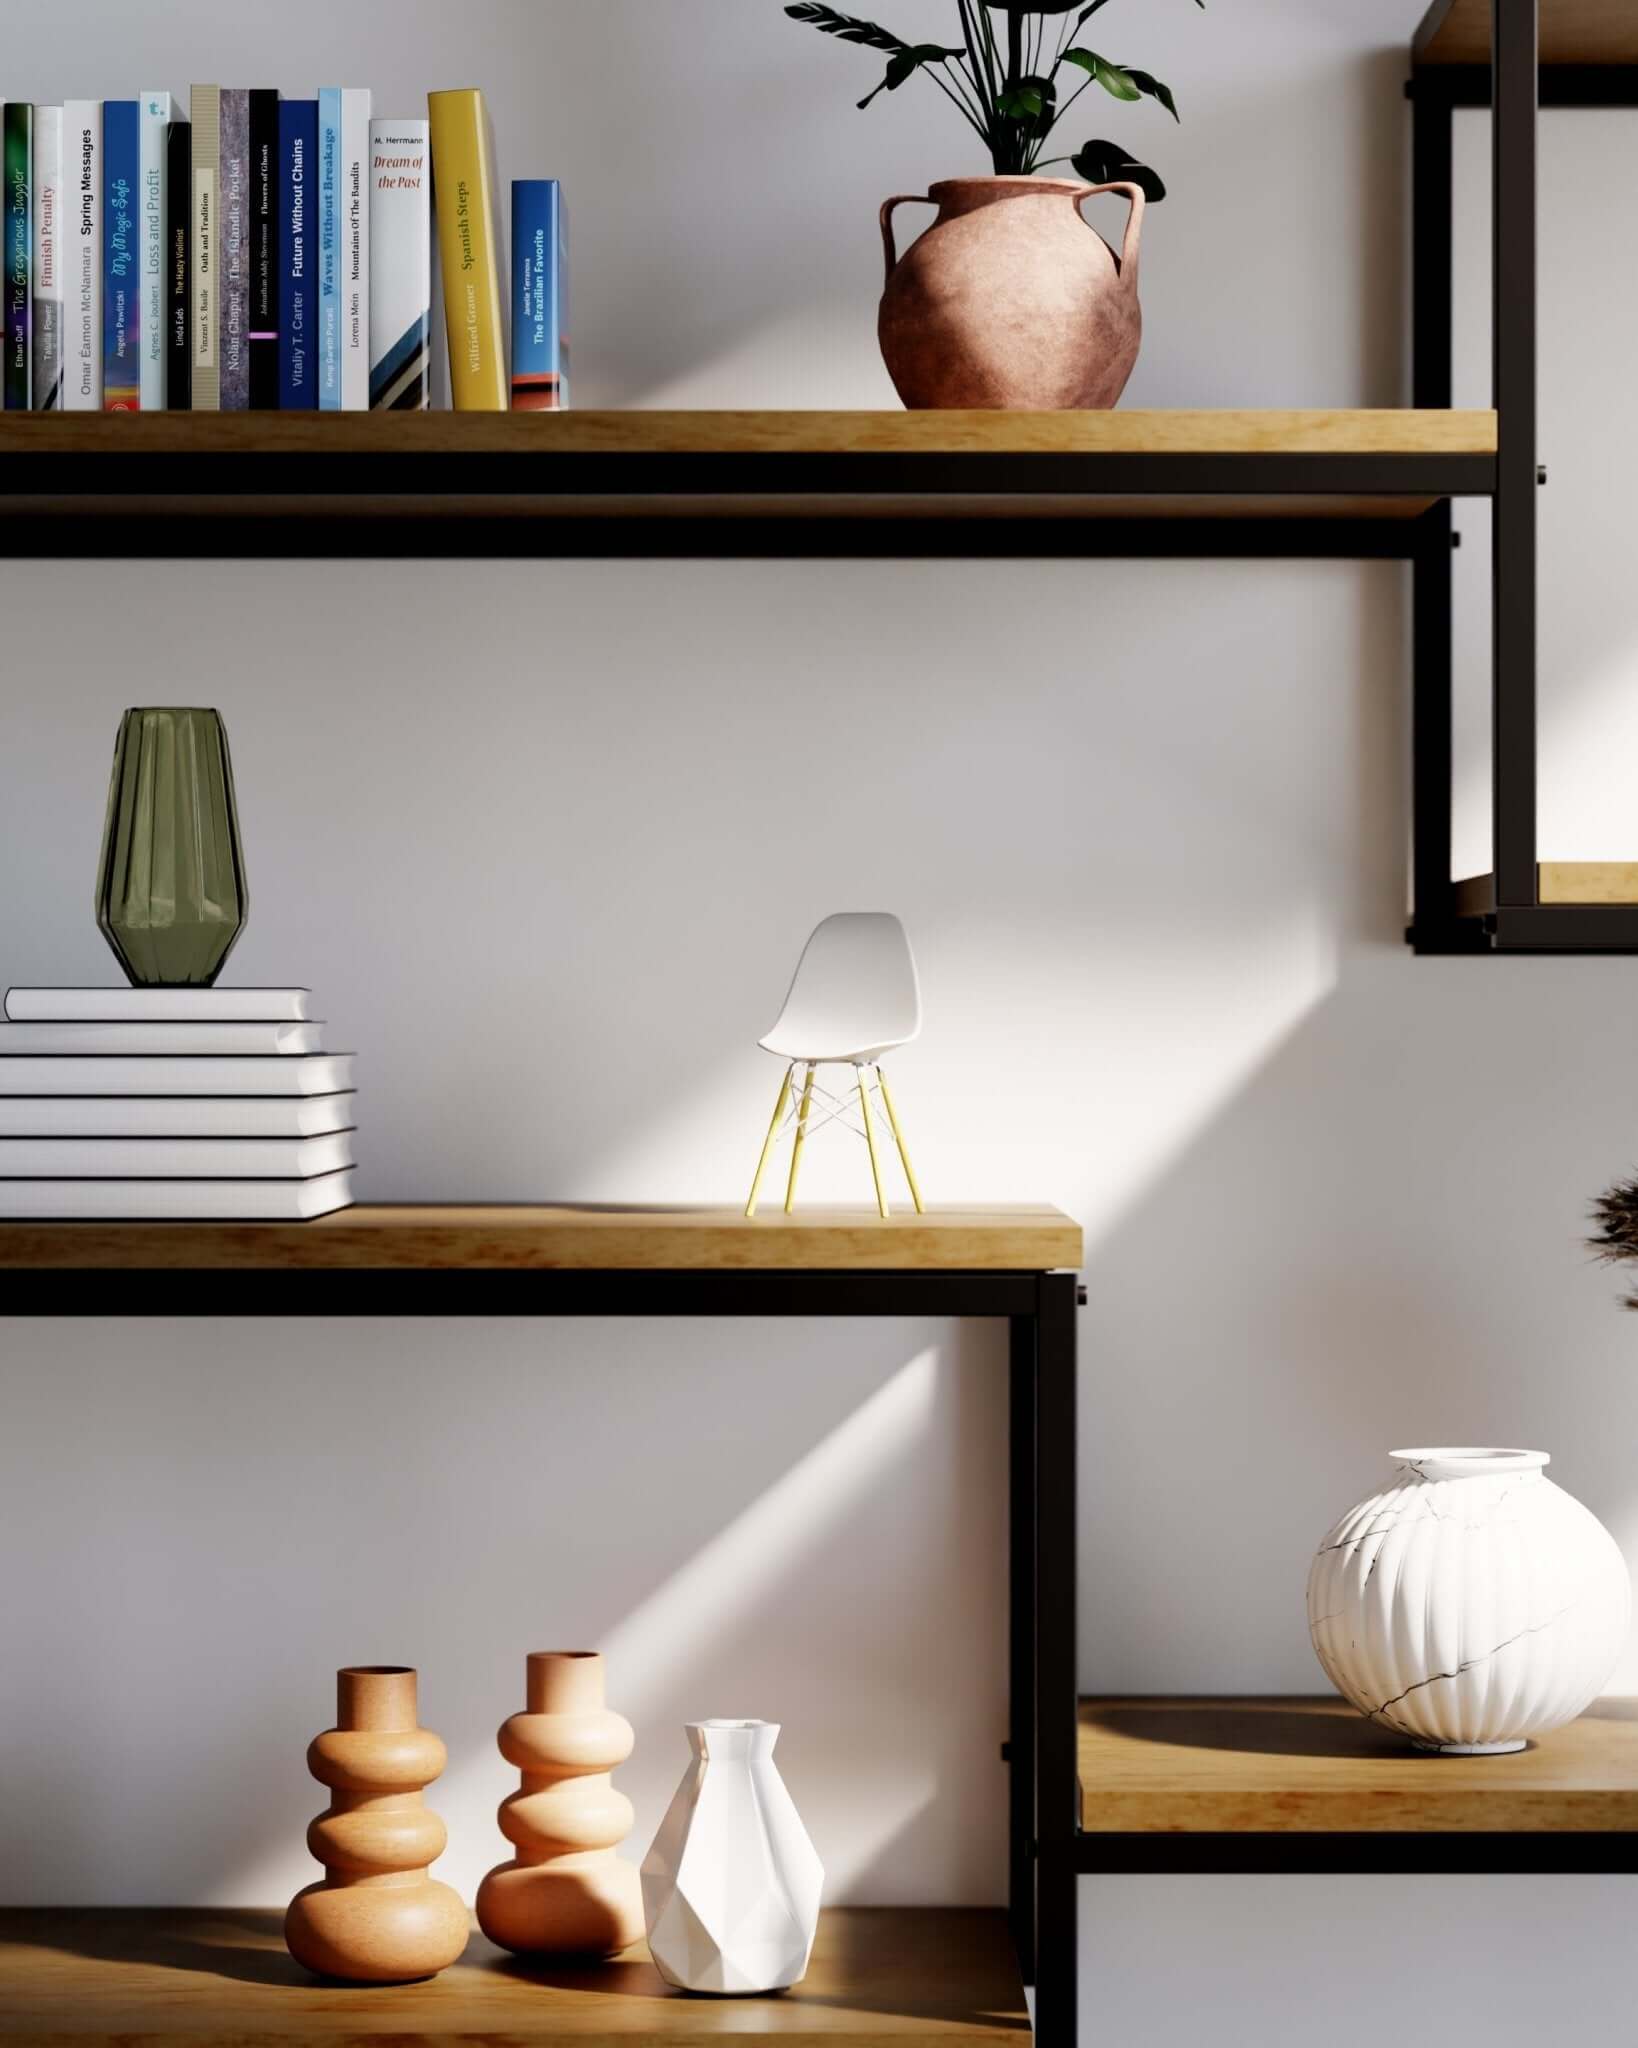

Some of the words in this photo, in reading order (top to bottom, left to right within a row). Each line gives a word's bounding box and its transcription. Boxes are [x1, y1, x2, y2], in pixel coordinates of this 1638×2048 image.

[80, 130, 93, 190] Messages
[293, 139, 302, 181] Chains
[323, 128, 334, 190] Breakage
[374, 156, 410, 168] Dream
[413, 156, 423, 170] of
[13, 168, 28, 216] Juggler
[112, 179, 129, 208] Sofa
[147, 169, 159, 210] Profit
[230, 158, 239, 200] Pocket
[351, 162, 359, 197] Bandits
[378, 176, 396, 188] the
[398, 176, 420, 188] Past
[41, 186, 54, 235] Penalty
[80, 195, 93, 235] Spring
[293, 185, 302, 233] Without
[351, 200, 359, 216] The
[456, 182, 470, 216] Steps
[112, 212, 131, 249] Magic
[147, 215, 159, 240] and
[229, 205, 239, 253] Islandic
[323, 194, 333, 249] Without
[351, 218, 359, 229] Of
[13, 218, 28, 285] Gregarious
[41, 239, 52, 287] Finnish
[147, 244, 159, 274] Loss
[293, 237, 302, 277] Future
[351, 231, 359, 280] Mountains
[458, 220, 474, 270] Spanish
[534, 229, 543, 272] Favorite
[80, 247, 91, 311] McNamara
[112, 252, 131, 276] My
[176, 260, 185, 280] Hasty
[230, 258, 239, 280] The
[261, 260, 269, 277] Addy
[324, 254, 333, 296] Waves
[13, 289, 24, 314] The
[43, 304, 52, 330] Power
[116, 291, 125, 328] Pawlitzki
[150, 286, 158, 318] Joubert
[229, 292, 241, 334] Chaput
[293, 291, 302, 329] Carter
[534, 276, 543, 322] Brazilian
[78, 316, 91, 358] Éamon
[116, 330, 125, 357] Angela
[150, 332, 160, 360] Agnes
[293, 333, 302, 345] T.
[469, 326, 481, 372] Wilfried
[534, 325, 543, 344] The
[229, 337, 239, 370] Nolan
[293, 348, 304, 386] Vitaliy
[81, 362, 91, 395] Omar
[326, 365, 334, 387] Kemp
